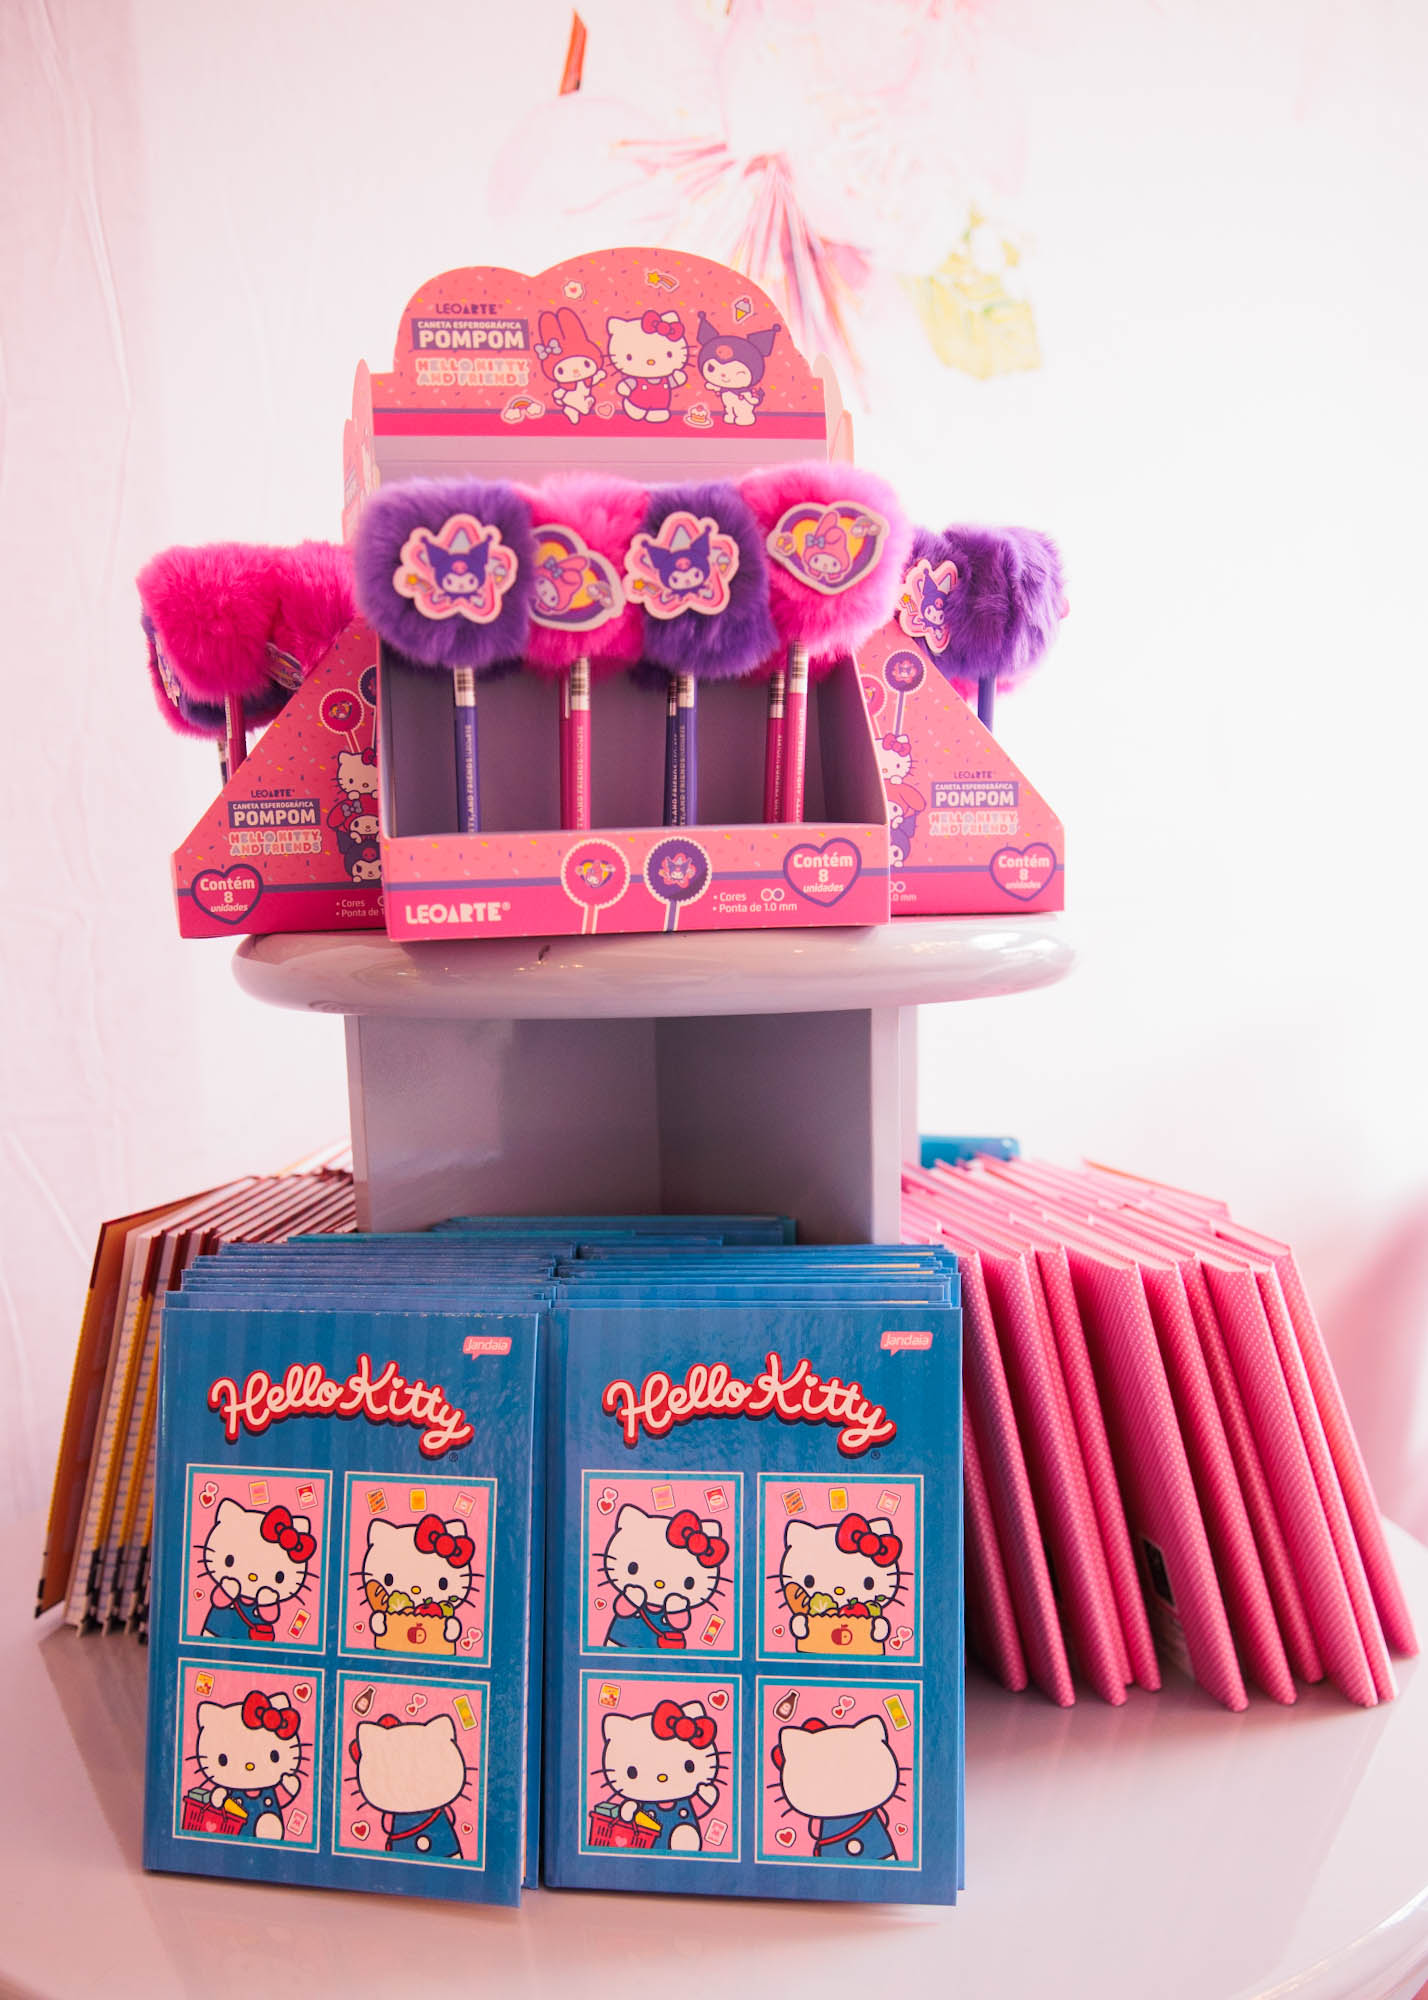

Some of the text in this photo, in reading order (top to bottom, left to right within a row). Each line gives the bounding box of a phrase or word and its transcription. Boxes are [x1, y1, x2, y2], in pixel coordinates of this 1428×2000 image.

[436, 303, 497, 314] LEOARTE
[417, 320, 522, 329] CANETA ESFEROGRÁFICA
[419, 330, 525, 349] POMPOM
[416, 358, 529, 372] HELLO KITTY
[417, 372, 529, 386] AND FRIENDS
[935, 791, 1014, 806] POMPOM
[234, 809, 316, 826] POMPOM
[229, 831, 276, 844] HELLO
[230, 842, 321, 856] AND FRIENDS
[793, 852, 853, 868] Contém
[998, 854, 1050, 868] Contém
[818, 869, 829, 882] 8
[1019, 868, 1028, 880] 8
[200, 876, 255, 891] Contém
[803, 883, 844, 893] unidades
[223, 891, 233, 903] 8
[341, 899, 366, 907] Cores
[719, 892, 746, 902] Cores
[210, 903, 249, 912] unidades
[341, 908, 367, 917] Ponta
[368, 907, 379, 916] de
[405, 902, 502, 924] LEOARTE
[719, 902, 797, 913] Ponta de 1.0 mm
[208, 1353, 474, 1457] Hello Kitty
[602, 1352, 897, 1458] Hello Kitty
